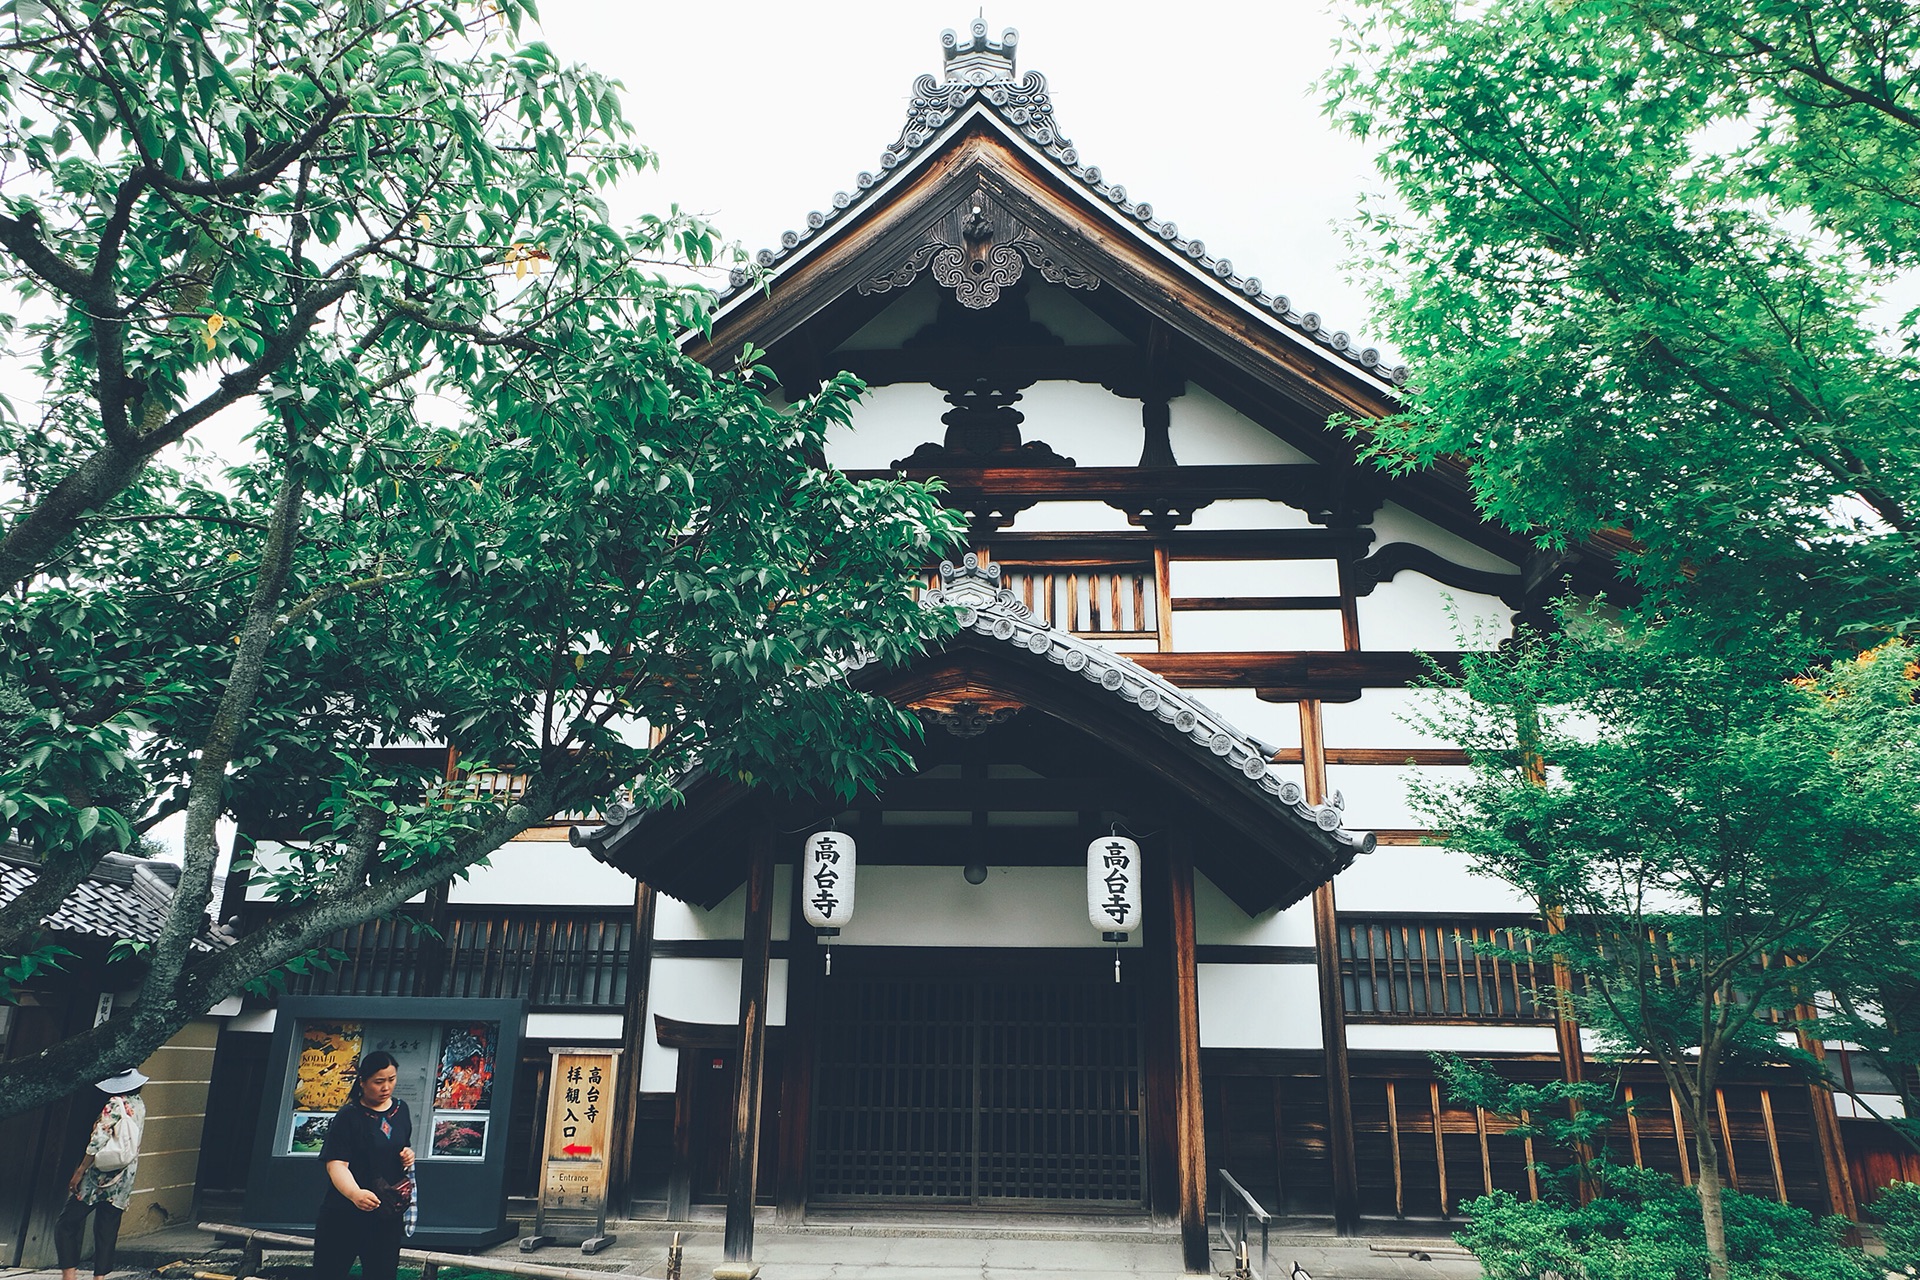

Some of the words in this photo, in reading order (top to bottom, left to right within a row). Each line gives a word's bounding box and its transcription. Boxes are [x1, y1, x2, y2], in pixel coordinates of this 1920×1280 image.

[811, 836, 841, 919] 高台寺
[1101, 842, 1131, 925] 高台寺
[563, 1066, 583, 1138] 拝観入口
[584, 1066, 602, 1124] 高台寺
[559, 1173, 589, 1182] Entrance
